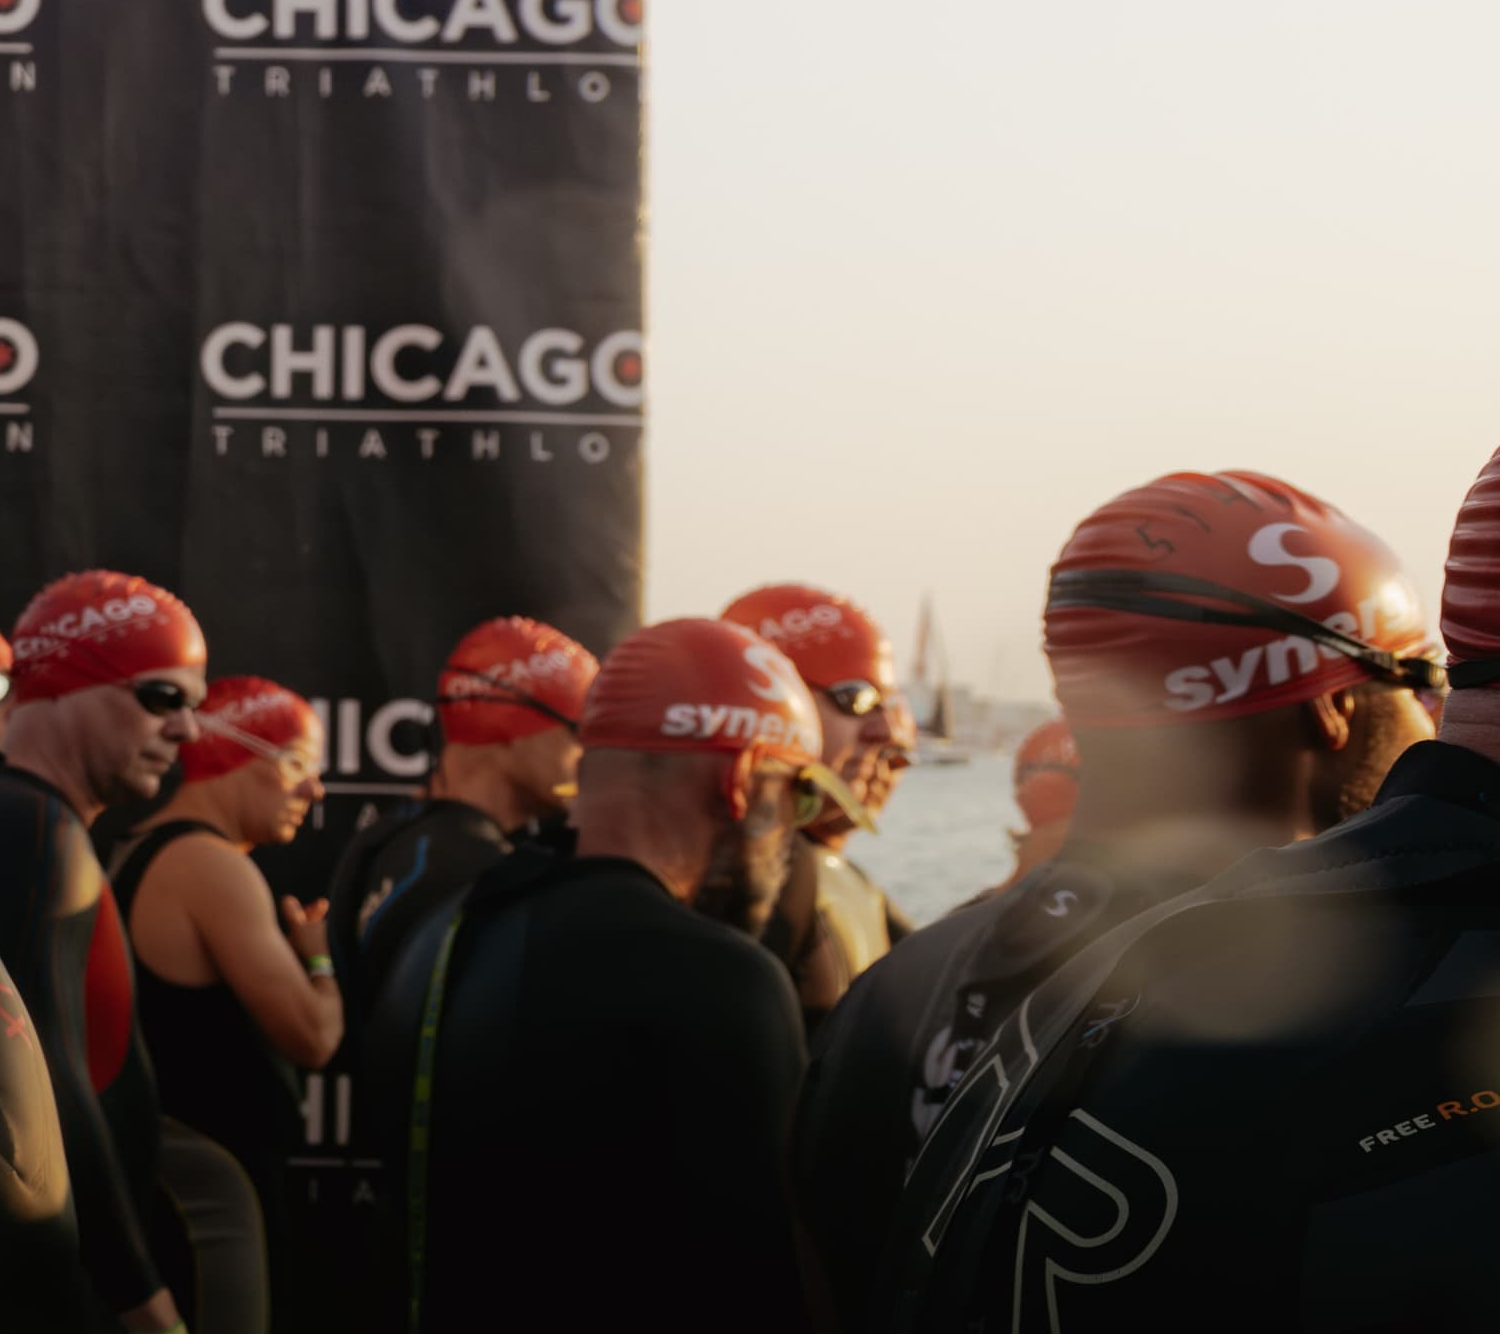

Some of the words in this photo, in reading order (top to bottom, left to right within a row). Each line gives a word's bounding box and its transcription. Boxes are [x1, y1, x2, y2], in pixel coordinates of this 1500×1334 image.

[213, 67, 612, 103] TRIATHLO
[213, 426, 611, 463] TRIATHLO
[1357, 1113, 1438, 1154] FREE
